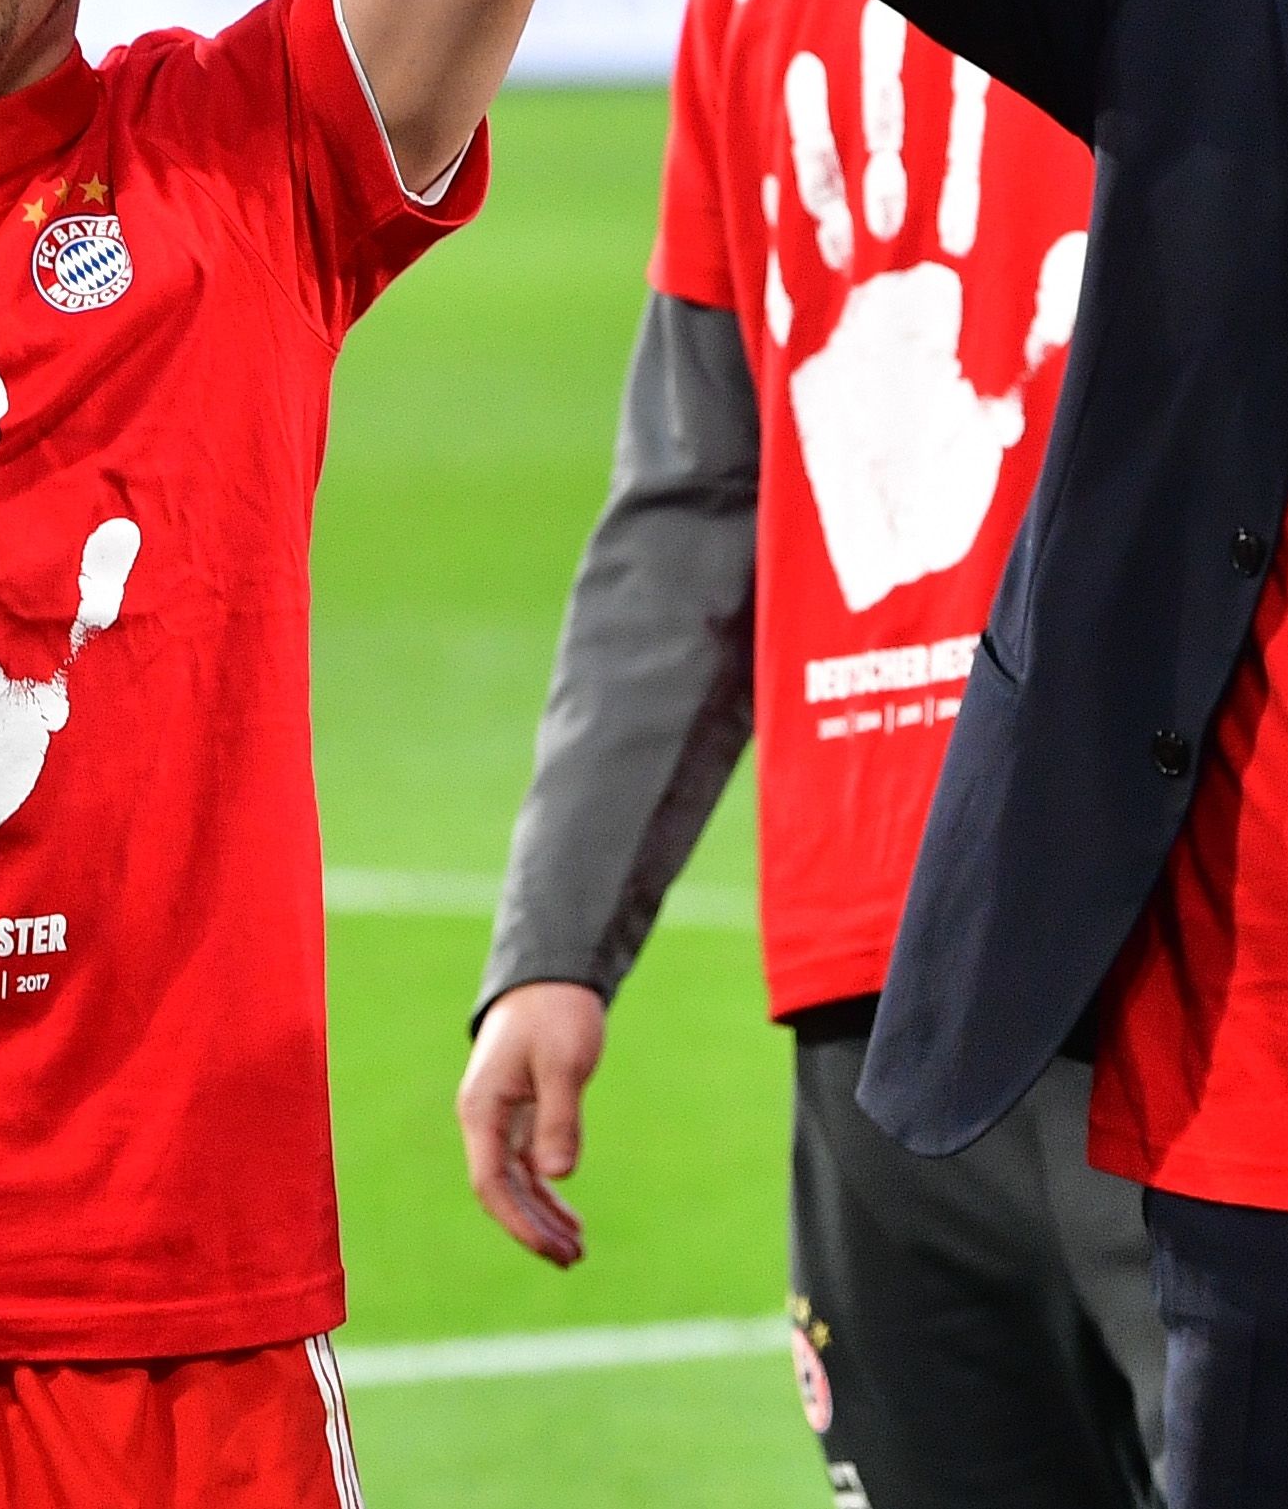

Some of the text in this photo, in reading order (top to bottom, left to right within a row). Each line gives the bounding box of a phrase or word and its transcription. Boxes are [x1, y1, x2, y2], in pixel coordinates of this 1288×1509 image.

[38, 221, 121, 270] FC BAYER
[16, 973, 50, 993] 2017
